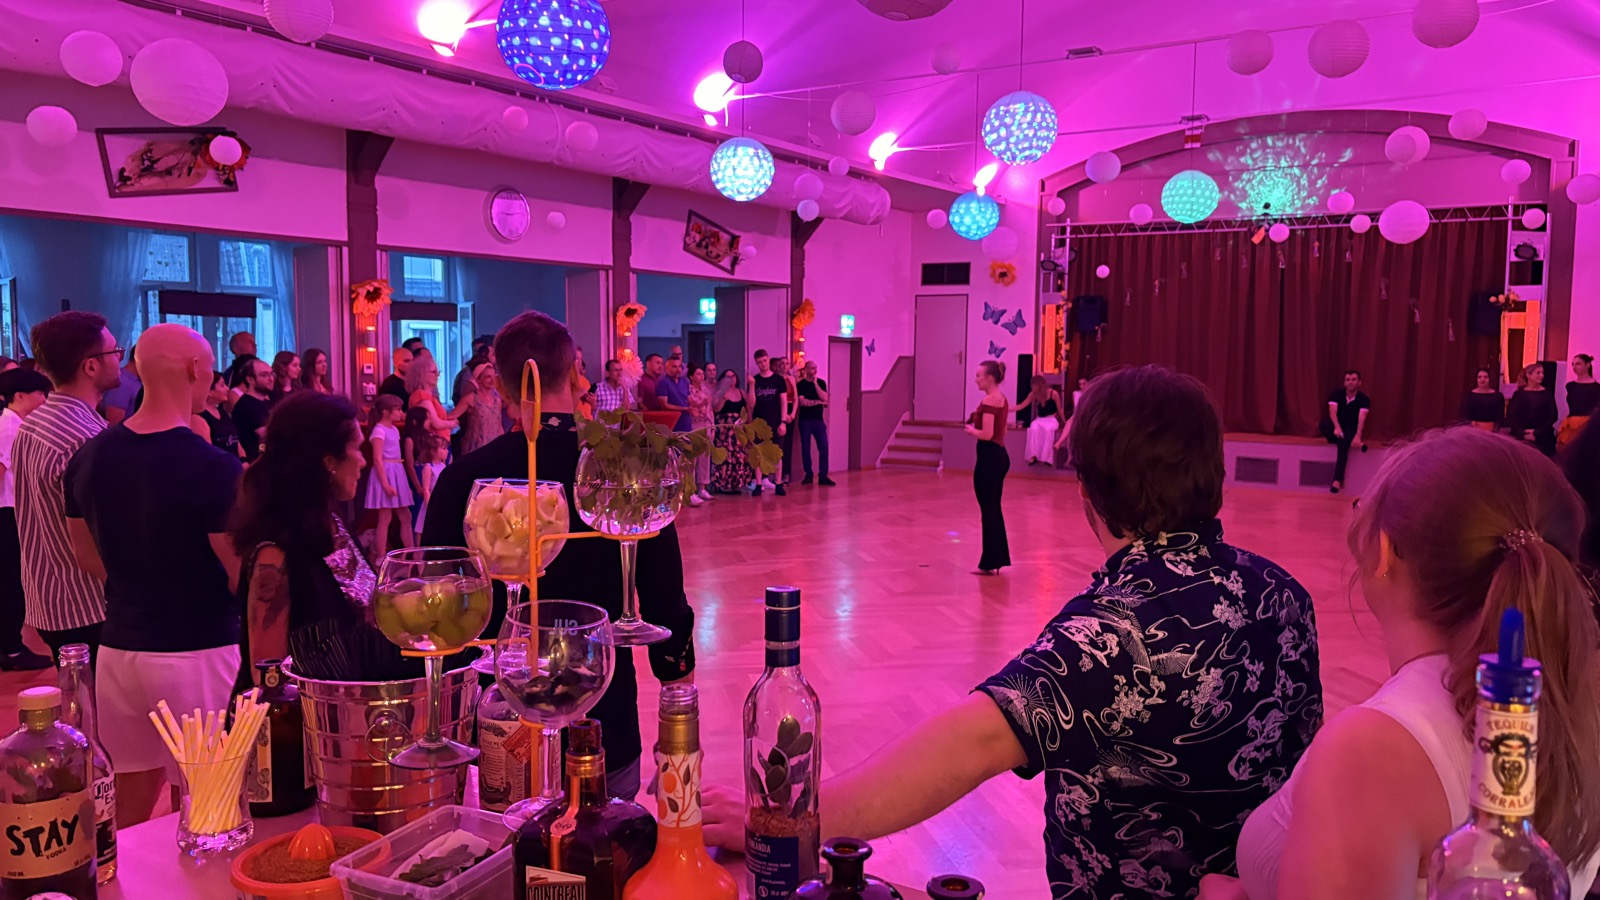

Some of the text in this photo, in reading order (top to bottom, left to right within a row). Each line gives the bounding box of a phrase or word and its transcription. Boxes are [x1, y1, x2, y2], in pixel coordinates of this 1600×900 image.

[1486, 718, 1535, 735] TEQUILA
[5, 813, 80, 858] STAY
[528, 884, 585, 900] COINTREAU
